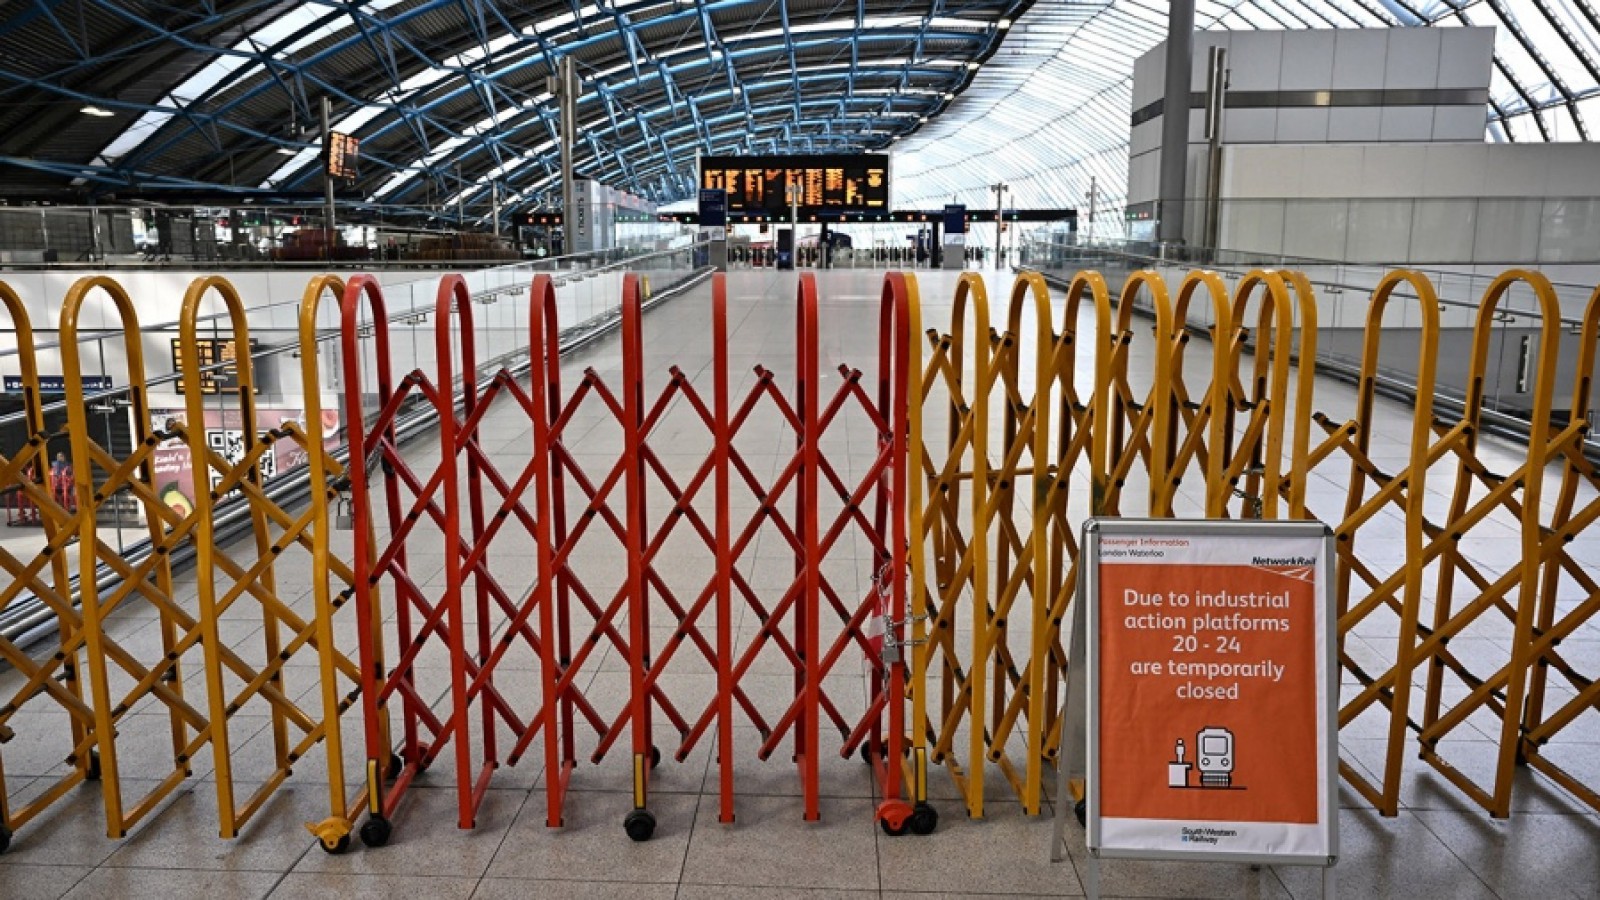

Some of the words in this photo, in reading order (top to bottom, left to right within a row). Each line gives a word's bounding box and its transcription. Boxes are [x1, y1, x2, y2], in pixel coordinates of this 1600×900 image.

[1098, 536, 1138, 547] Passenger
[1140, 538, 1189, 546] Information
[1098, 549, 1127, 557] London
[1128, 549, 1164, 557] Waterloo
[1124, 588, 1163, 606] Due
[1168, 591, 1190, 607] to
[1195, 590, 1290, 608] industrial
[1124, 613, 1186, 629] action
[1193, 612, 1290, 633] platforms
[1172, 634, 1197, 652] 20
[1216, 635, 1241, 653] 24
[1130, 661, 1162, 675] are
[1168, 659, 1285, 682] temporarily
[1176, 681, 1238, 700] closed
[1188, 835, 1218, 845] Railway
